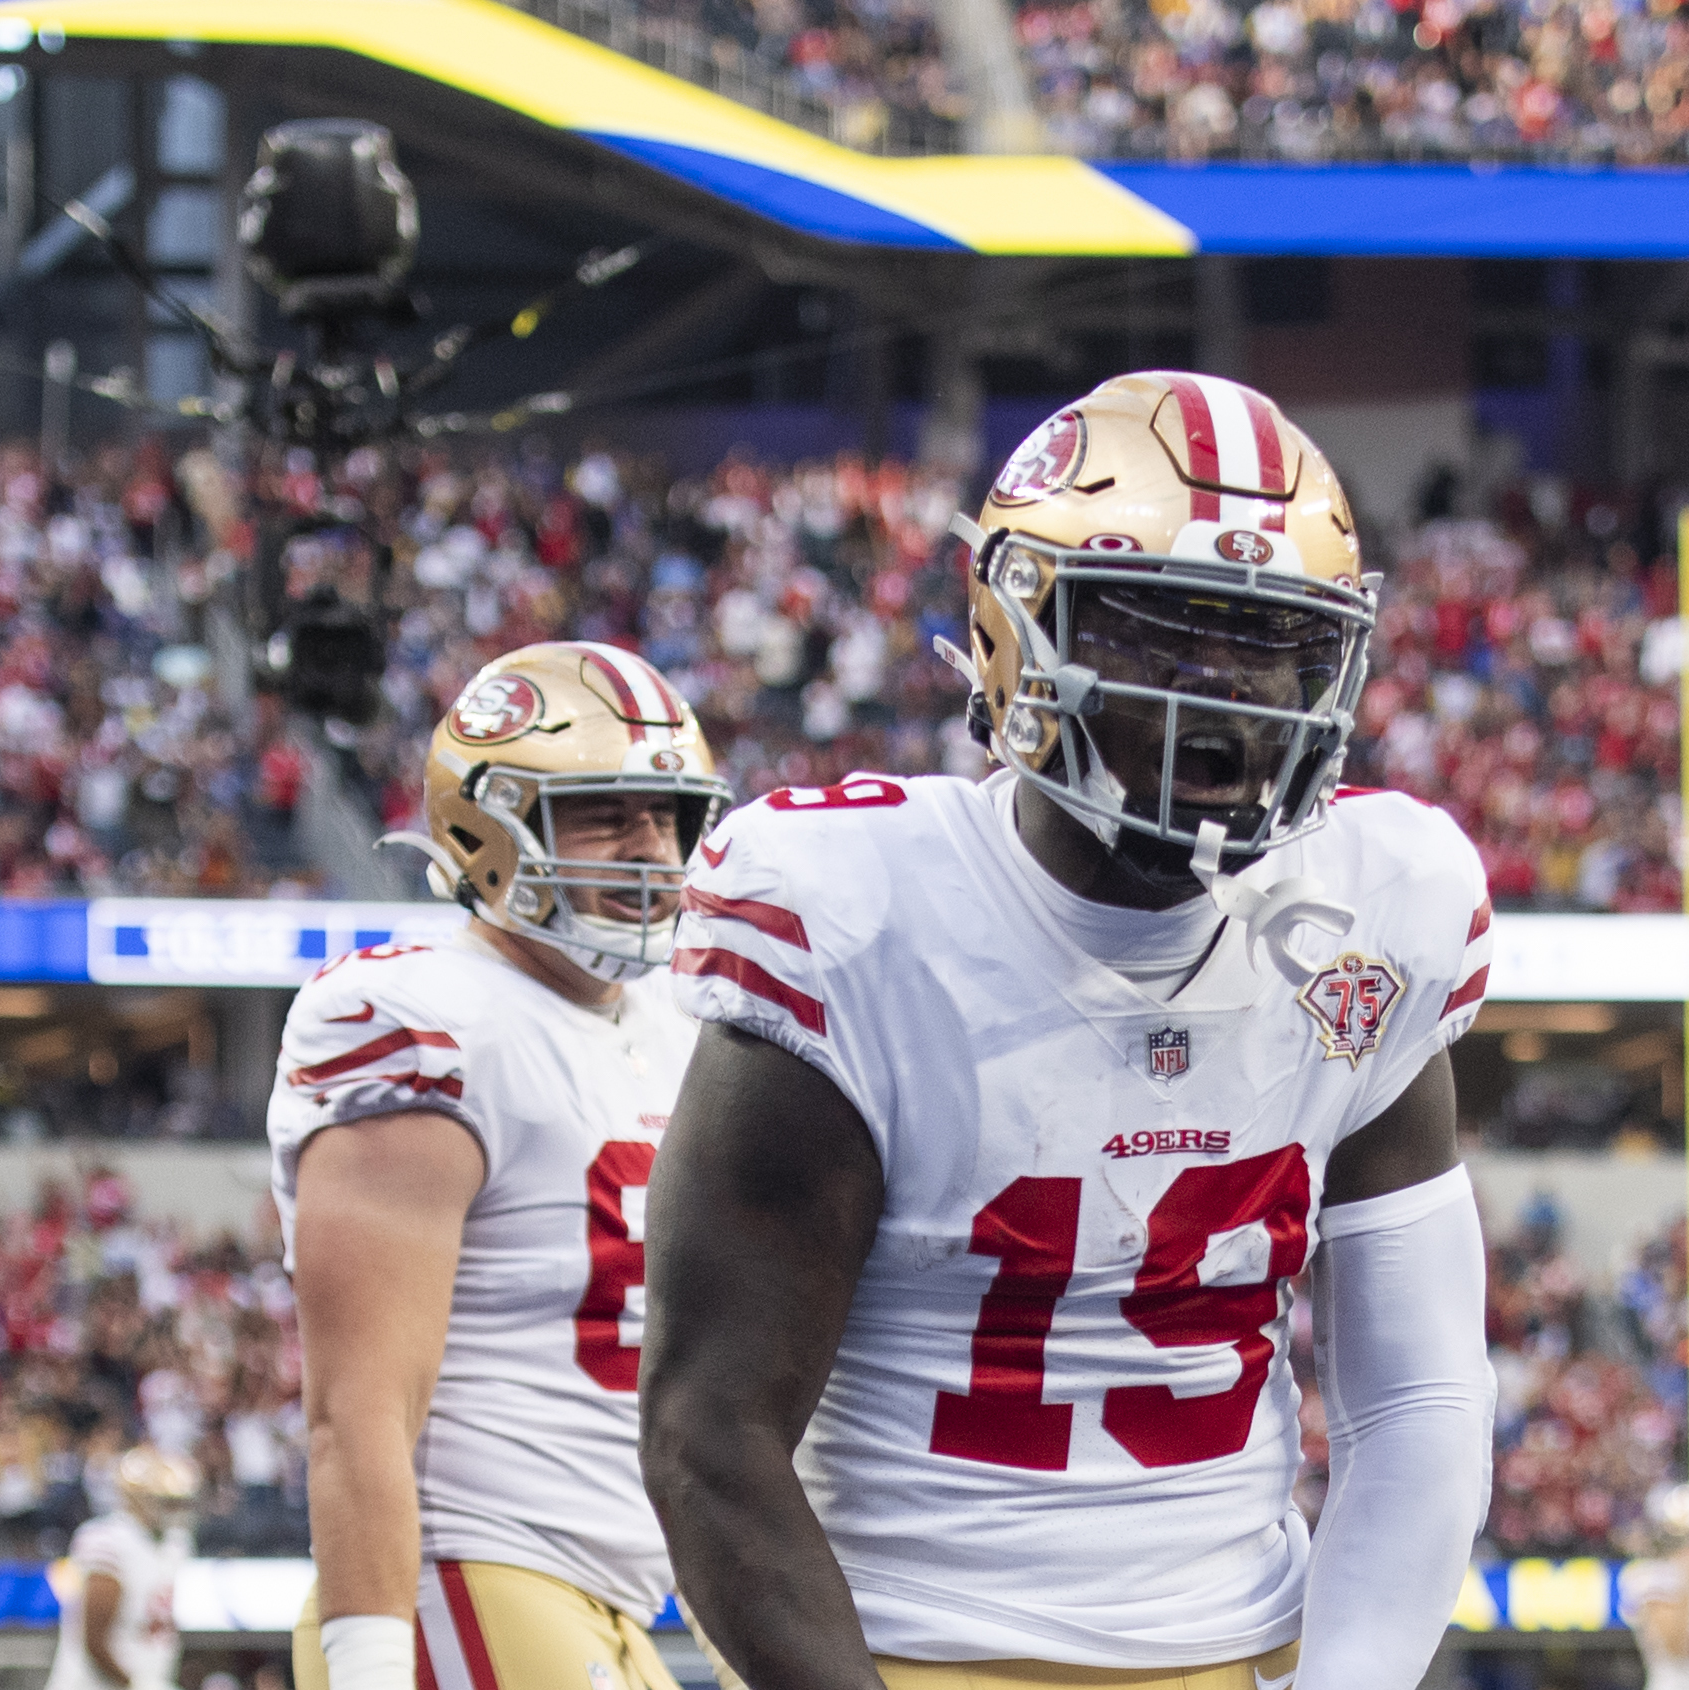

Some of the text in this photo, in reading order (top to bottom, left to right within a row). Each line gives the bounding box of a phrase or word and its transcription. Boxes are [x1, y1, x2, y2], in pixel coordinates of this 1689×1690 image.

[1324, 976, 1382, 1035] 75
[1152, 1048, 1187, 1075] NFL
[1101, 1128, 1232, 1160] 49ERS
[929, 1141, 1311, 1472] 19
